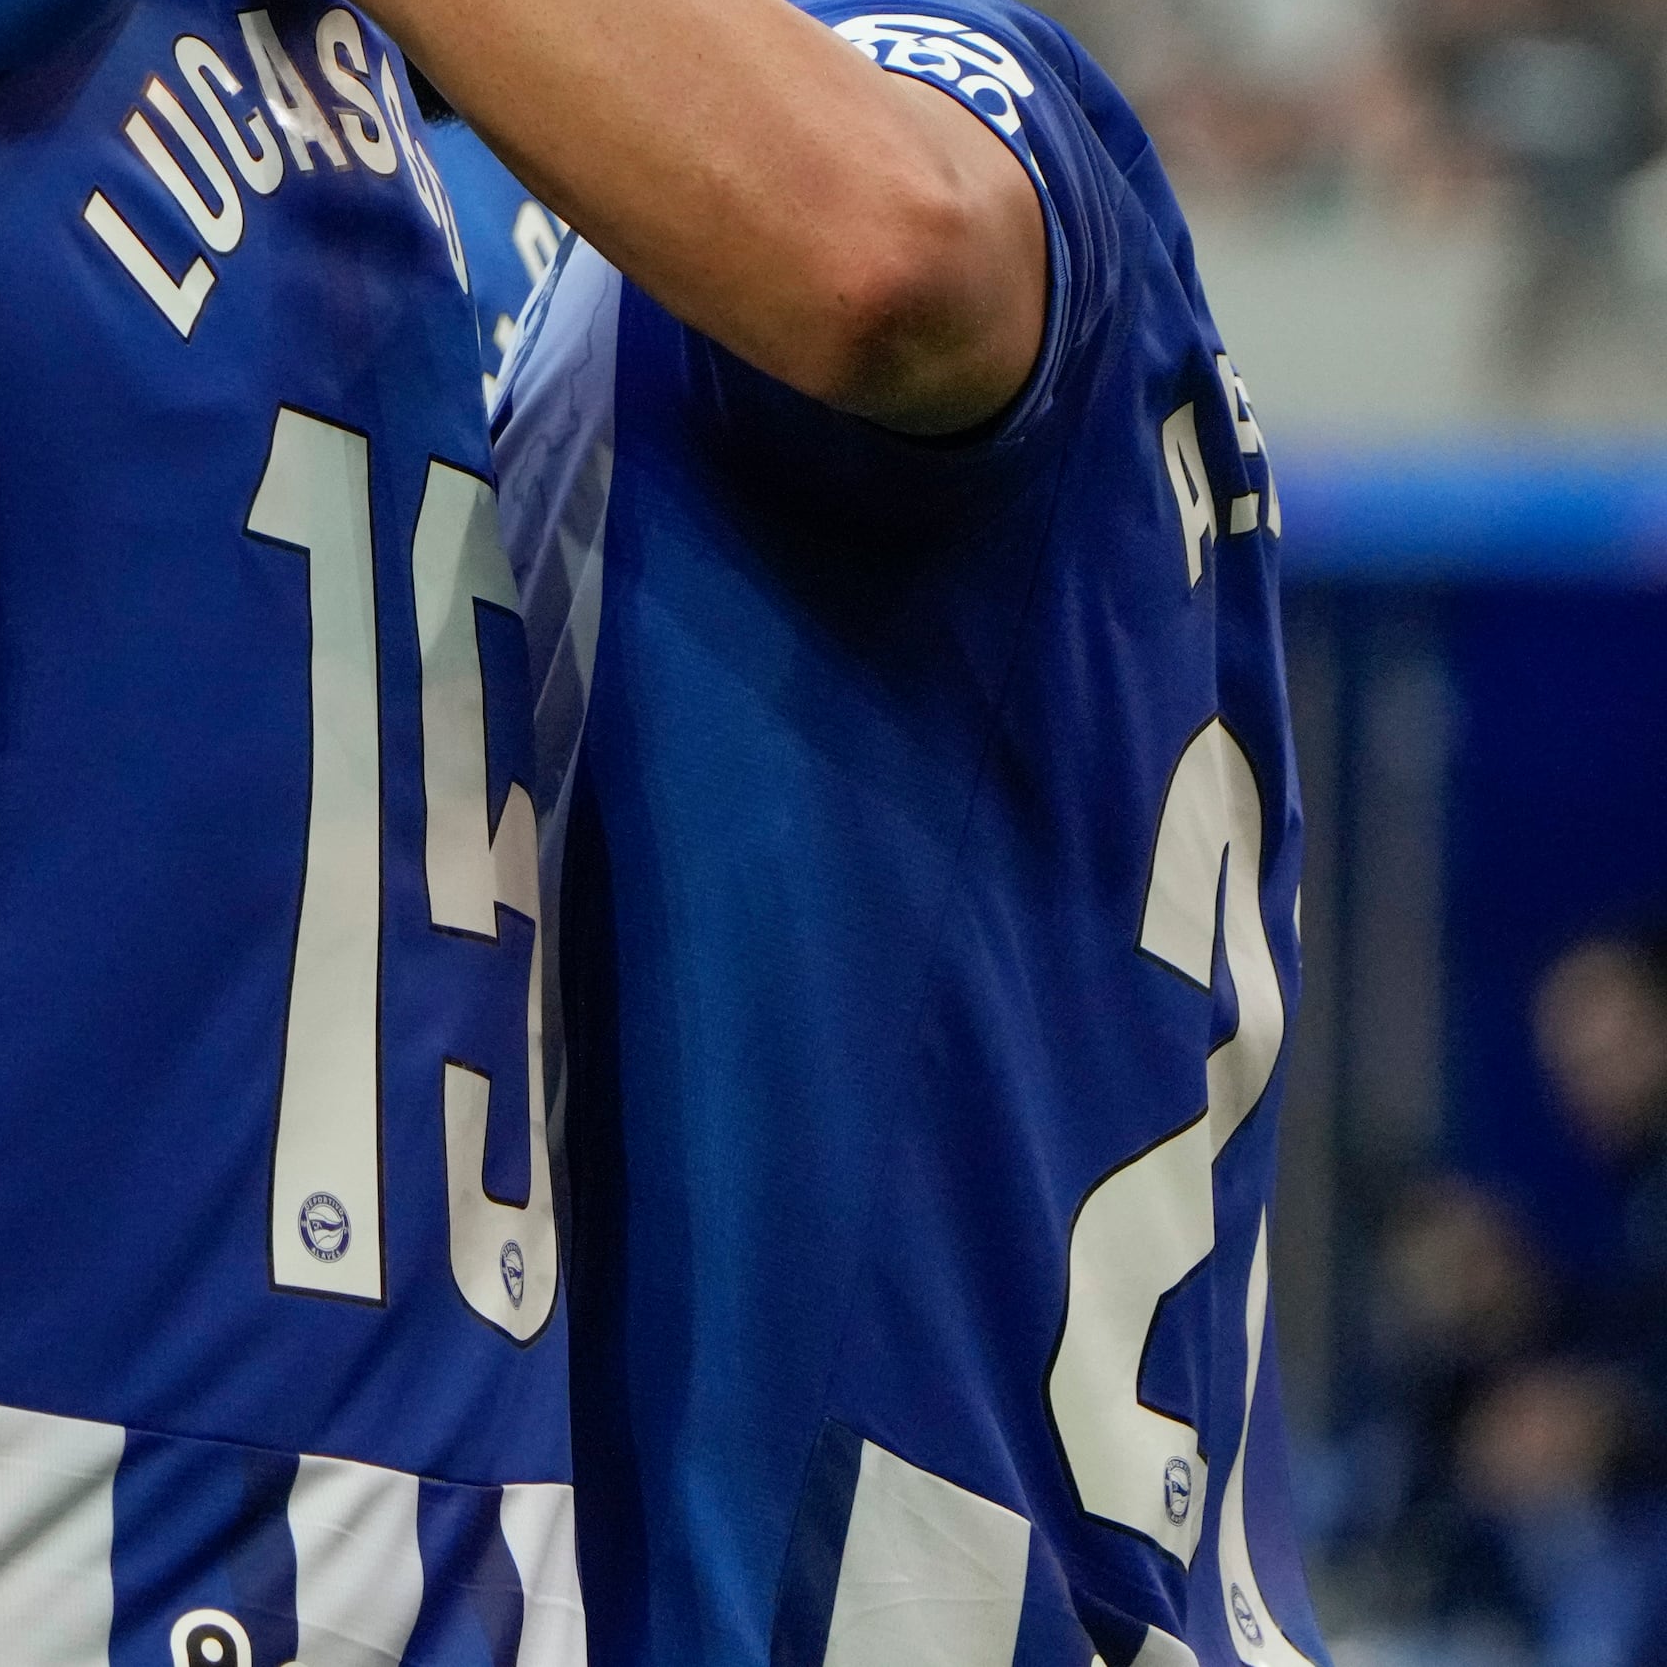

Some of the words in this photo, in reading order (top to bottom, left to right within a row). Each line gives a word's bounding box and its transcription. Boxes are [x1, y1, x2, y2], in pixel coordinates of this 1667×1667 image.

[83, 6, 398, 340] LUCAS
[246, 404, 559, 1346] 15
[304, 1194, 345, 1217] DEPORTIVO
